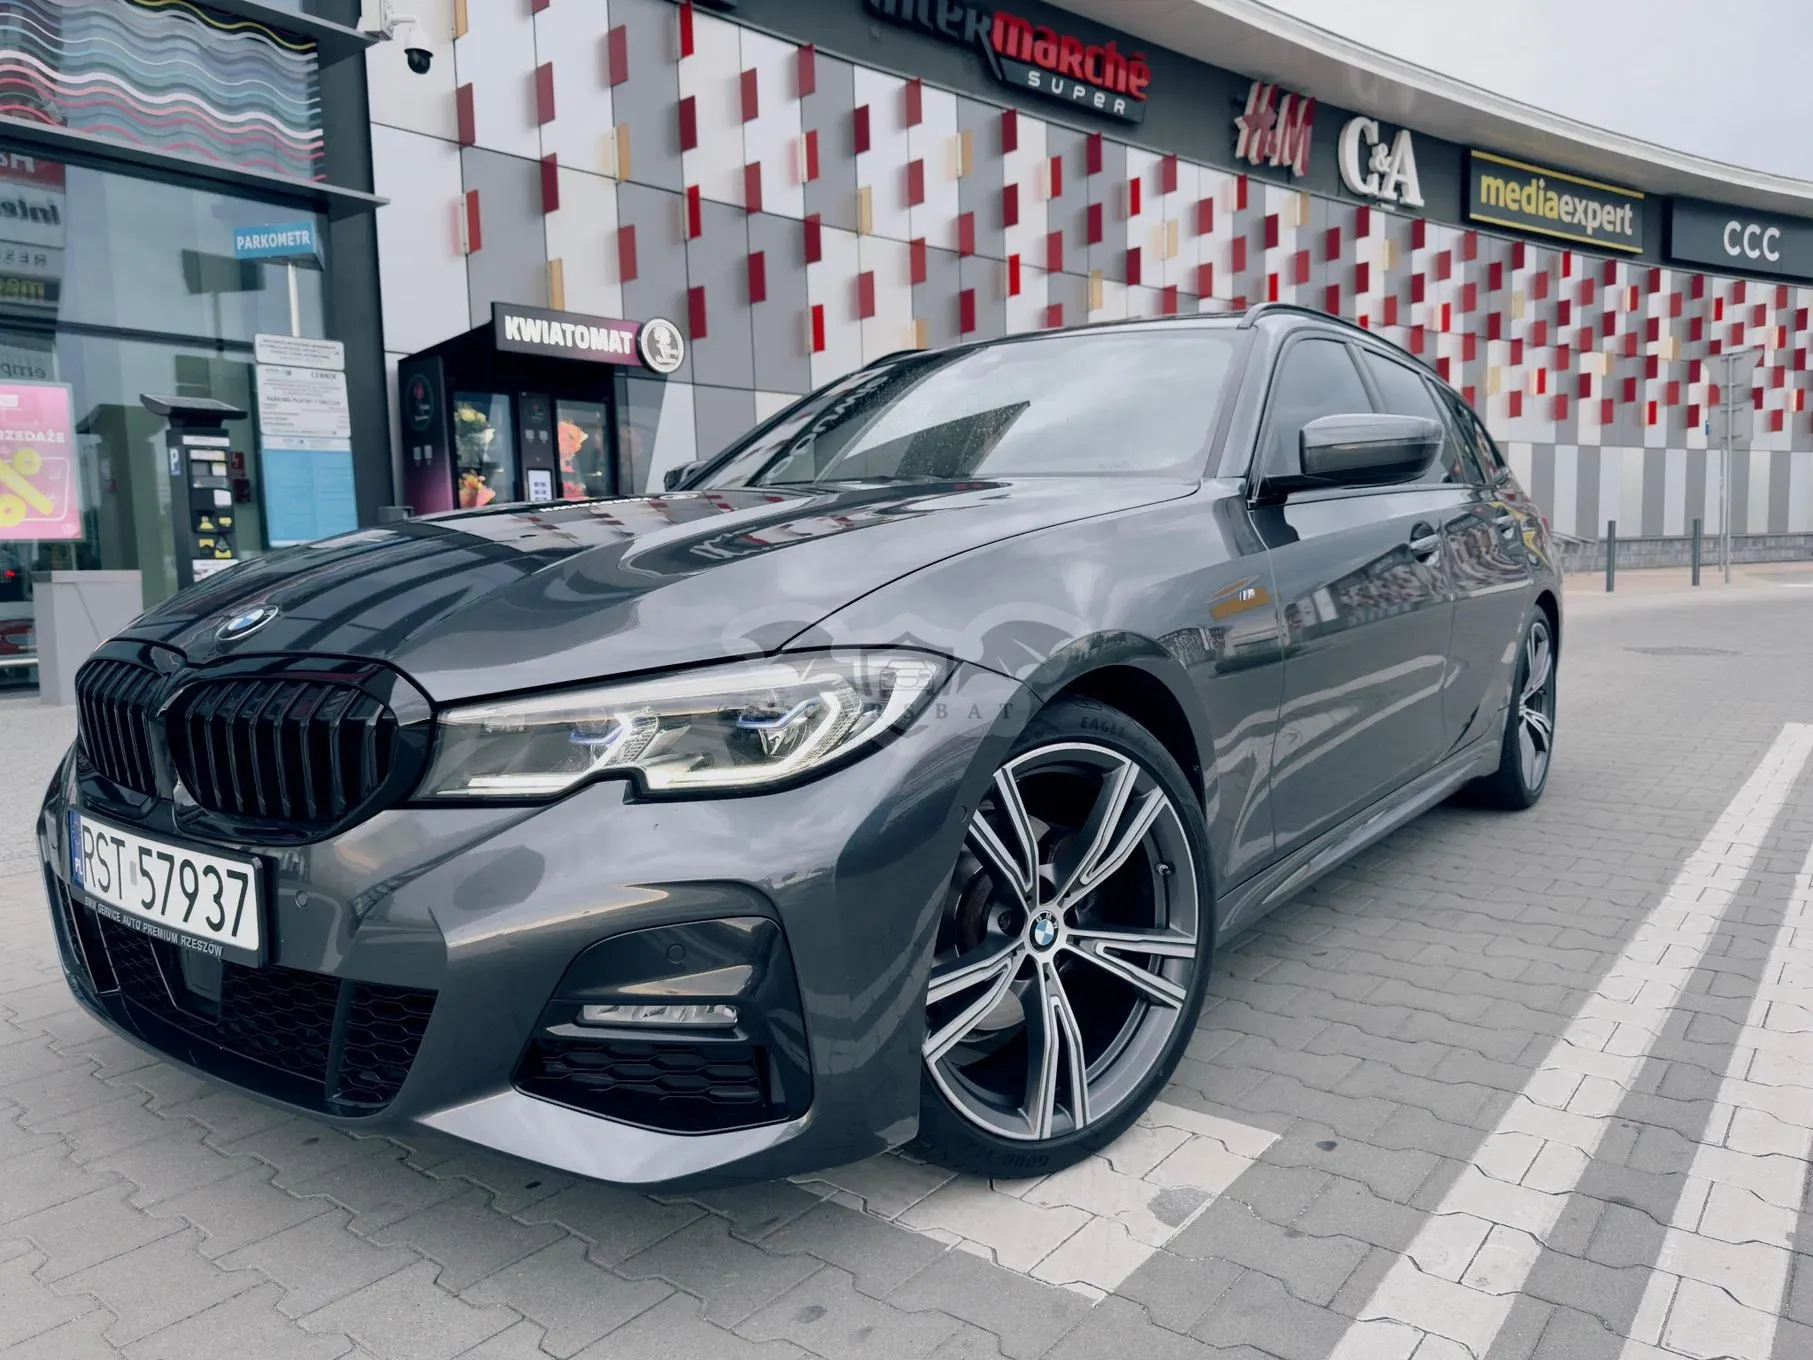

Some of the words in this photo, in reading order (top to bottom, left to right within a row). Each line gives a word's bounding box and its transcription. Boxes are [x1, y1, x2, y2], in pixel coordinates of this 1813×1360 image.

[868, 0, 1152, 101] termarché
[1234, 80, 1316, 177] H&M
[1337, 114, 1425, 208] C&A
[1479, 172, 1634, 238] mediaexpert
[236, 230, 311, 250] PARKOMETR
[1721, 220, 1781, 262] CCC
[504, 315, 634, 355] KWIATOMAT
[169, 448, 180, 471] P
[82, 825, 126, 901] RST
[138, 846, 249, 938] 57937
[97, 903, 121, 922] SERVICE
[122, 915, 141, 931] AUTO
[143, 922, 178, 945] PREMIUM
[180, 934, 224, 957] RZESZÓW
[1036, 912, 1059, 930] BMW
